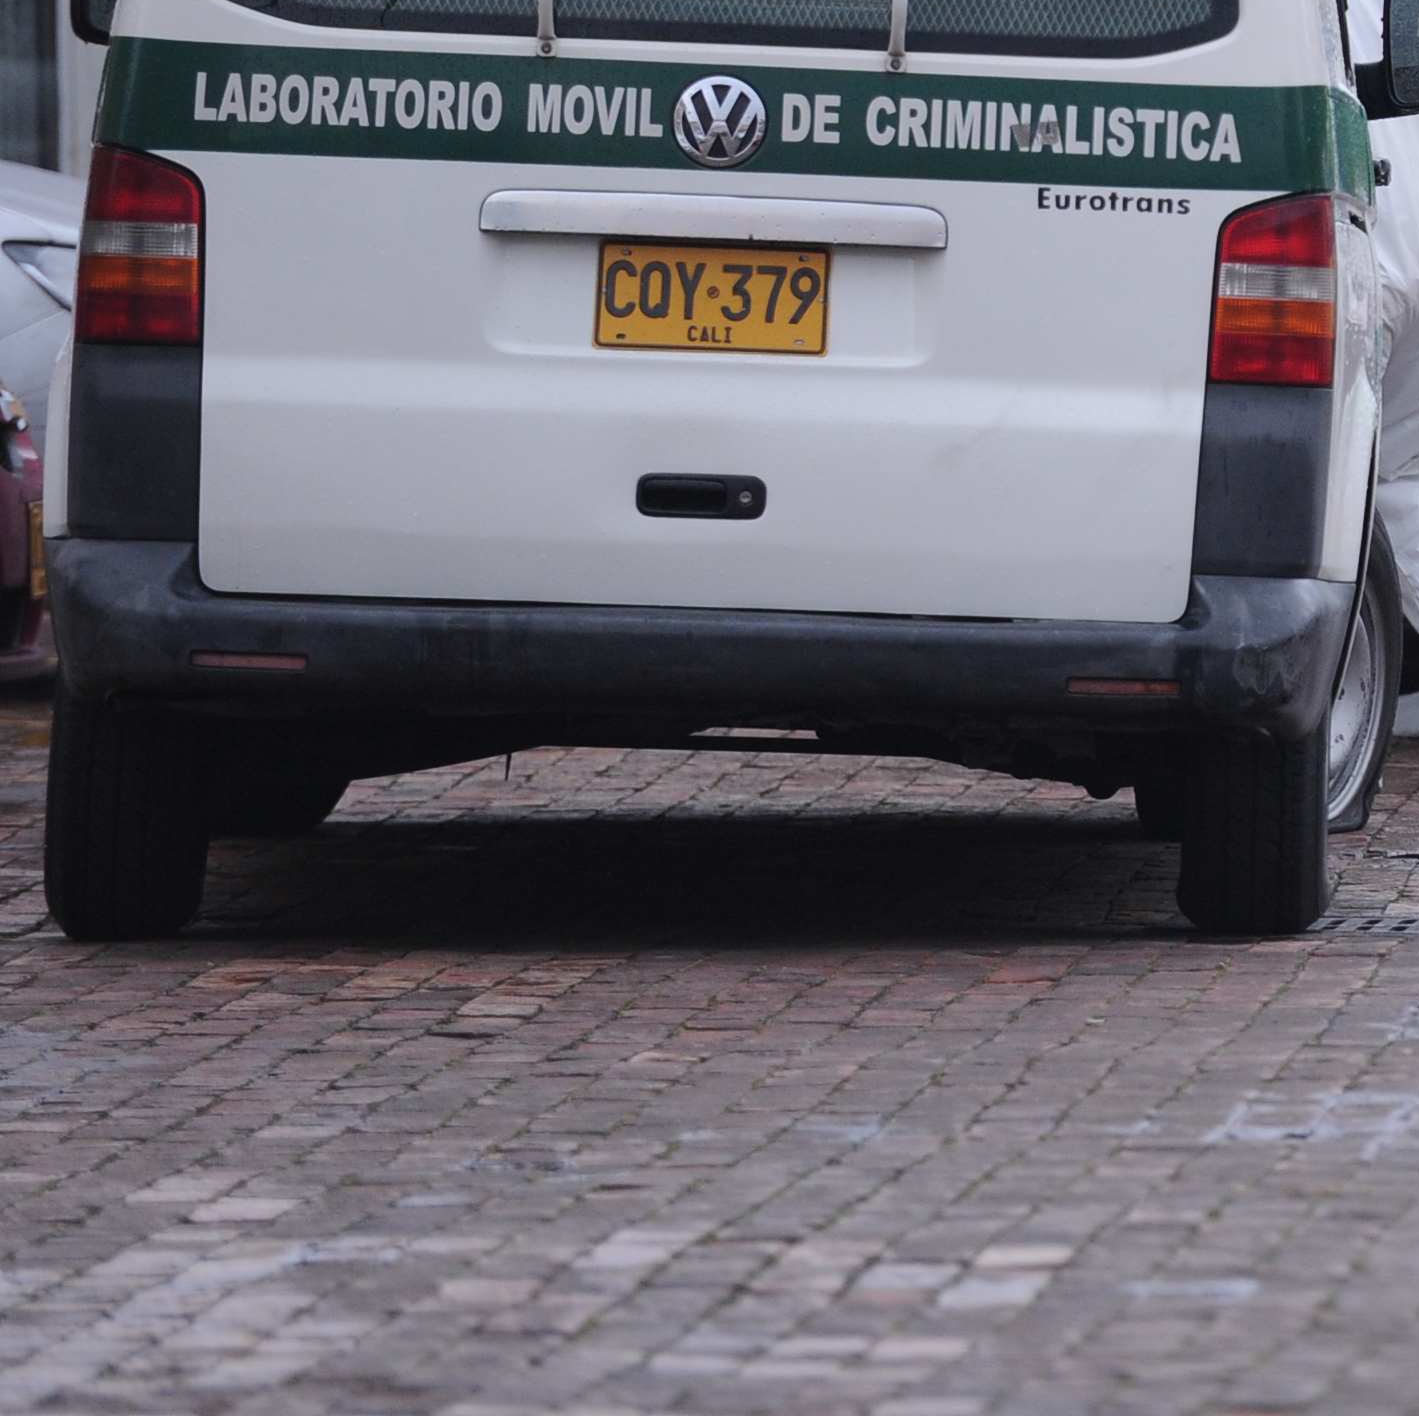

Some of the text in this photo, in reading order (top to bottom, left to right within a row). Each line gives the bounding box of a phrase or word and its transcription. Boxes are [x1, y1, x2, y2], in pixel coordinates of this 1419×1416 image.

[193, 70, 1242, 164] LABORATORIO MOVIL DE CRIMINALISTICA
[1036, 187, 1192, 216] Eurotrans
[604, 259, 822, 325] CQY 379
[687, 324, 733, 344] CALI
